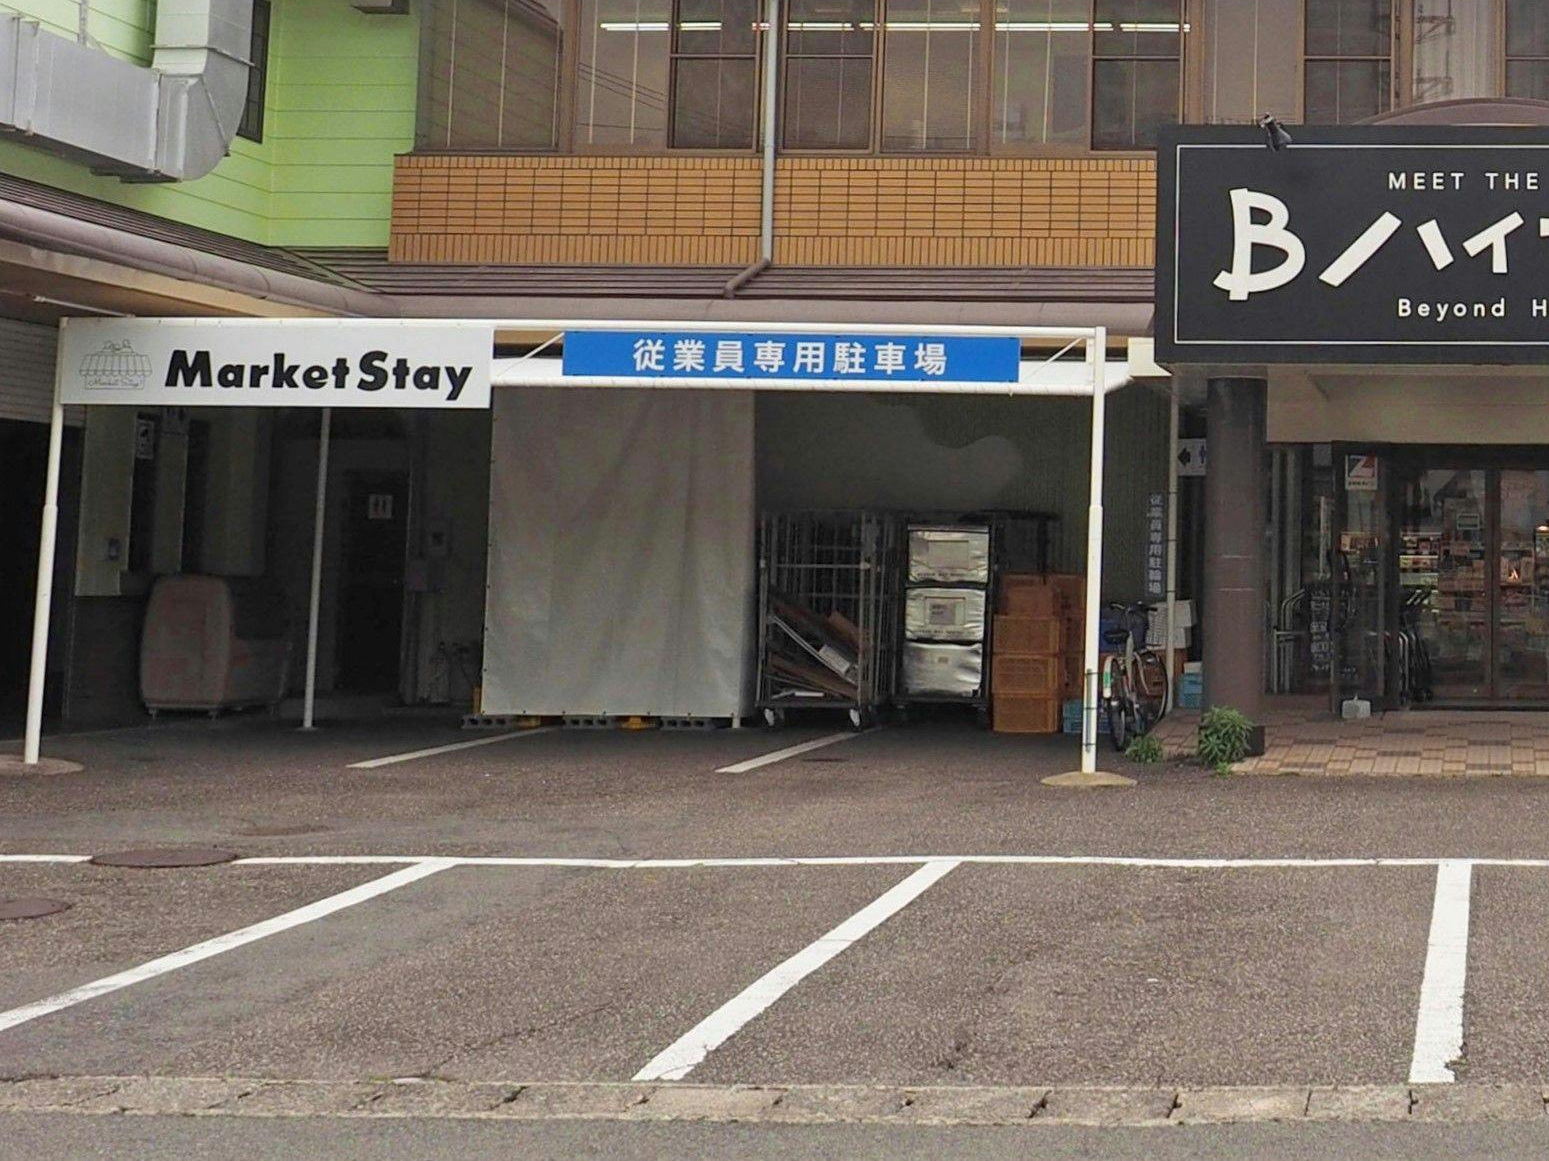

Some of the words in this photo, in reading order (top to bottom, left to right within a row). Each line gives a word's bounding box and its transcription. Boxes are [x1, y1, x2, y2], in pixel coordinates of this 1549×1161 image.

[1388, 172, 1465, 191] MEET
[1485, 172, 1539, 191] THE
[1398, 297, 1506, 322] Beyond
[632, 339, 948, 376] 従業員専用駐車場
[164, 349, 473, 401] MarketStay
